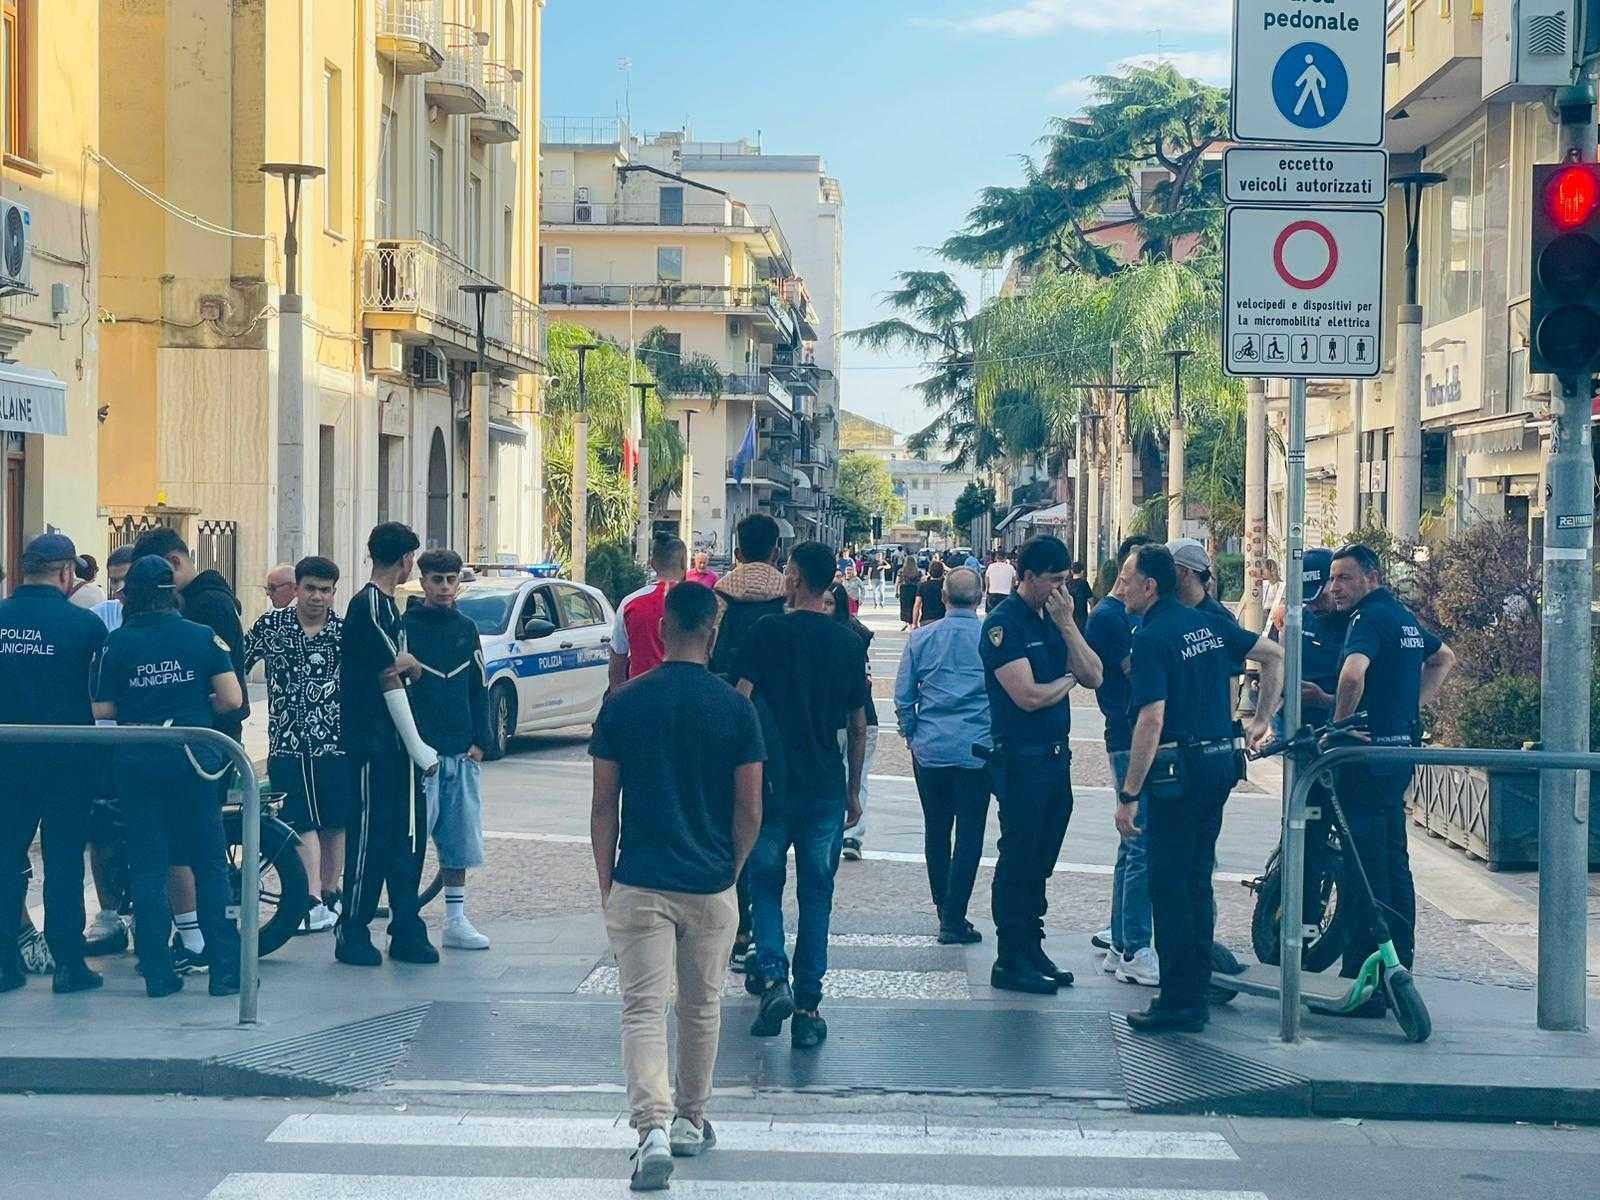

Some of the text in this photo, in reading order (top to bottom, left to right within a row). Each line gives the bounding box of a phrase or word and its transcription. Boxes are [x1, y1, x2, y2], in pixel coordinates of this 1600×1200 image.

[1264, 10, 1360, 31] pedonale
[1279, 158, 1334, 171] eccetto
[1240, 177, 1372, 193] veicoli autorizzati
[1236, 298, 1286, 312] velocipedi
[1303, 300, 1352, 313] dispositivi
[1357, 302, 1372, 312] per
[1238, 315, 1248, 326] la
[1328, 317, 1370, 328] elettrica
[0, 395, 32, 422] LAINE
[0, 628, 42, 641] POLIZIA
[1183, 627, 1214, 644] POLIZIA
[0, 642, 56, 656] UNICIPALE
[137, 660, 182, 676] POLIZIA
[538, 655, 563, 669] POLIZIA
[129, 670, 195, 687] MUNICIPALE
